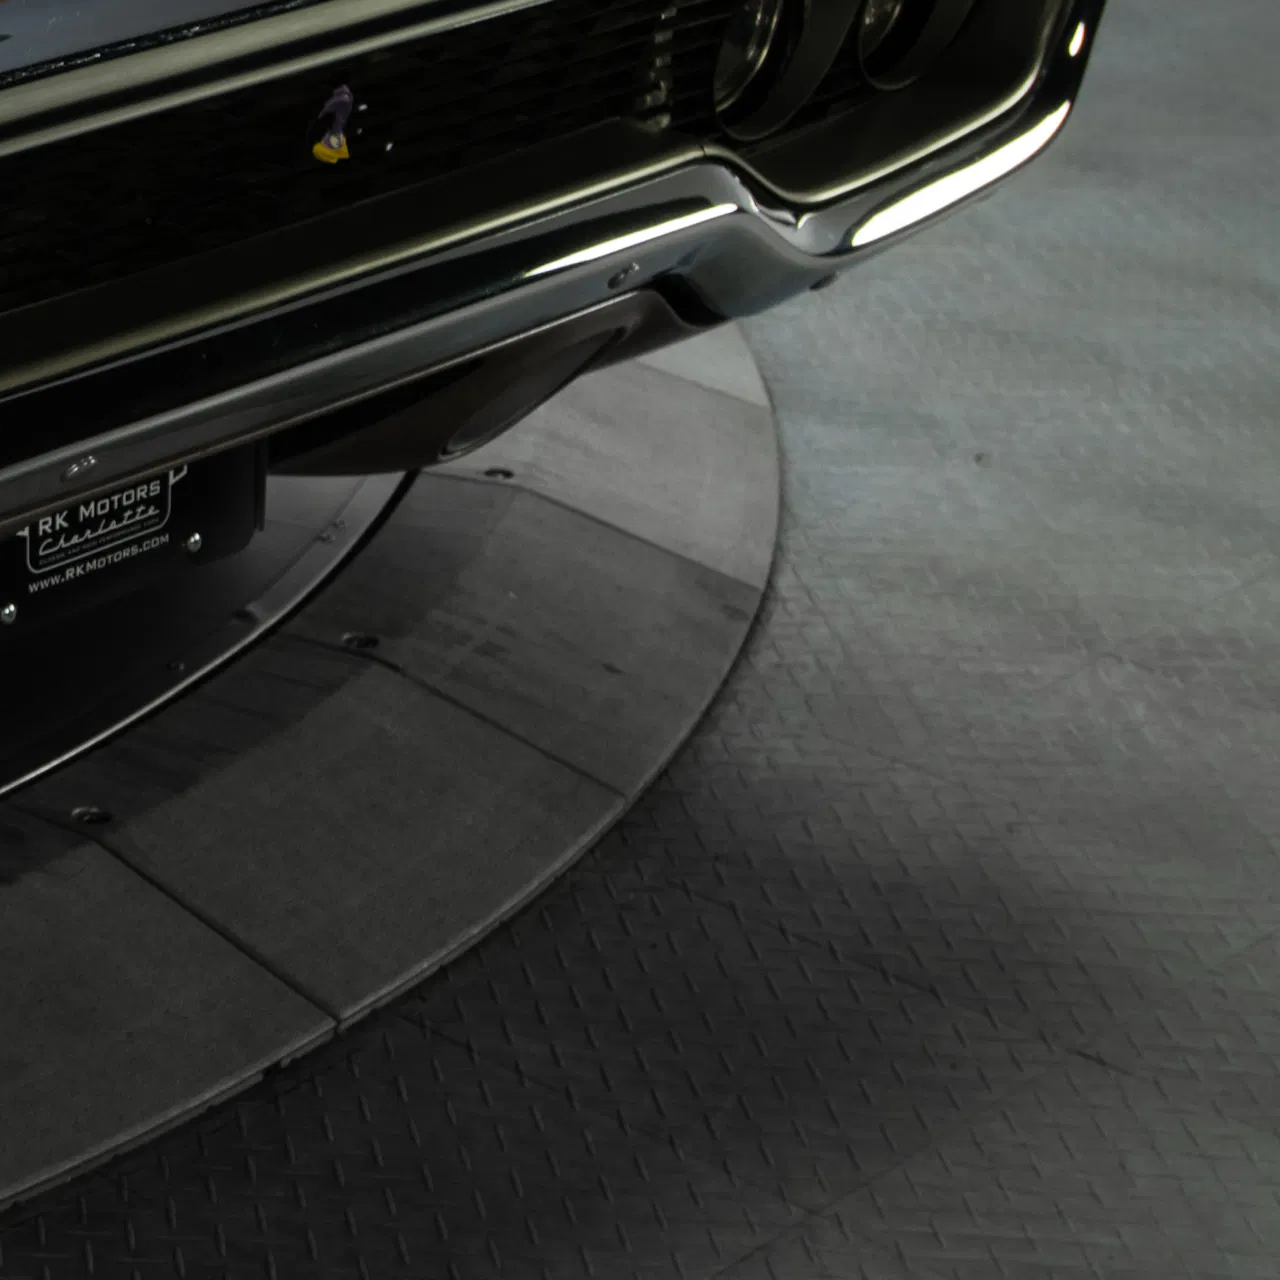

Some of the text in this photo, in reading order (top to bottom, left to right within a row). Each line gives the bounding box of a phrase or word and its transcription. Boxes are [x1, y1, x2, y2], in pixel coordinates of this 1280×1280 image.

[38, 504, 160, 555] Charlotte
[39, 480, 161, 536] RK MOTORS
